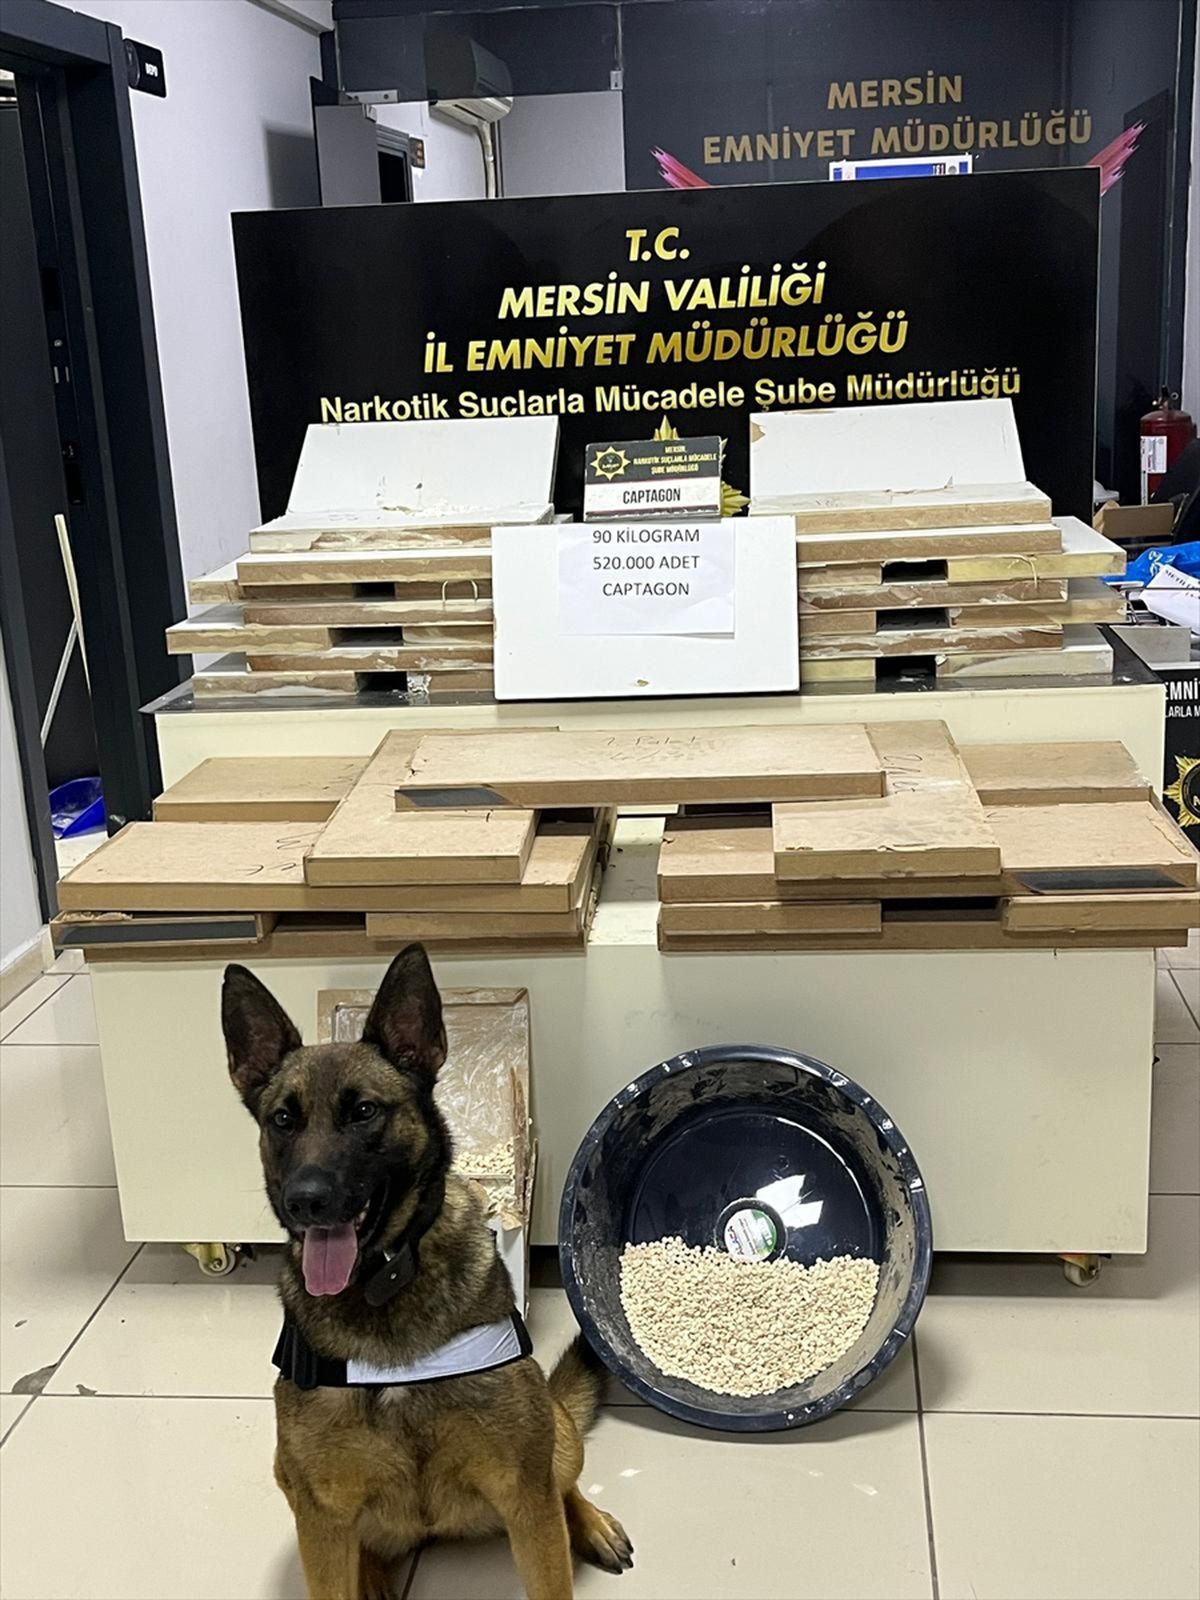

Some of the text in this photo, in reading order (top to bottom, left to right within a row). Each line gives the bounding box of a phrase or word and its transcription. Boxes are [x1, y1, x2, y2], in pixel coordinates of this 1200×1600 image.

[827, 70, 963, 110] MERSİN
[703, 109, 1093, 165] EMNİYET MÜDÜRLÜĞÜ
[625, 227, 690, 262] T.C.
[498, 260, 827, 319] MERSİN VALİLİĞİ
[424, 310, 909, 373] İL EMNİYET MÜDÜRLÜĞÜ
[320, 367, 1021, 423] Narkotik Suçlarla Mücadele Şube Müdürlüğü
[623, 488, 681, 504] CAPTAGON
[593, 527, 700, 544] 90 KİLOGRAM
[593, 555, 700, 570] 520.000 ADET
[602, 582, 689, 596] CAPTAGON
[1165, 677, 1200, 700] EMNİ
